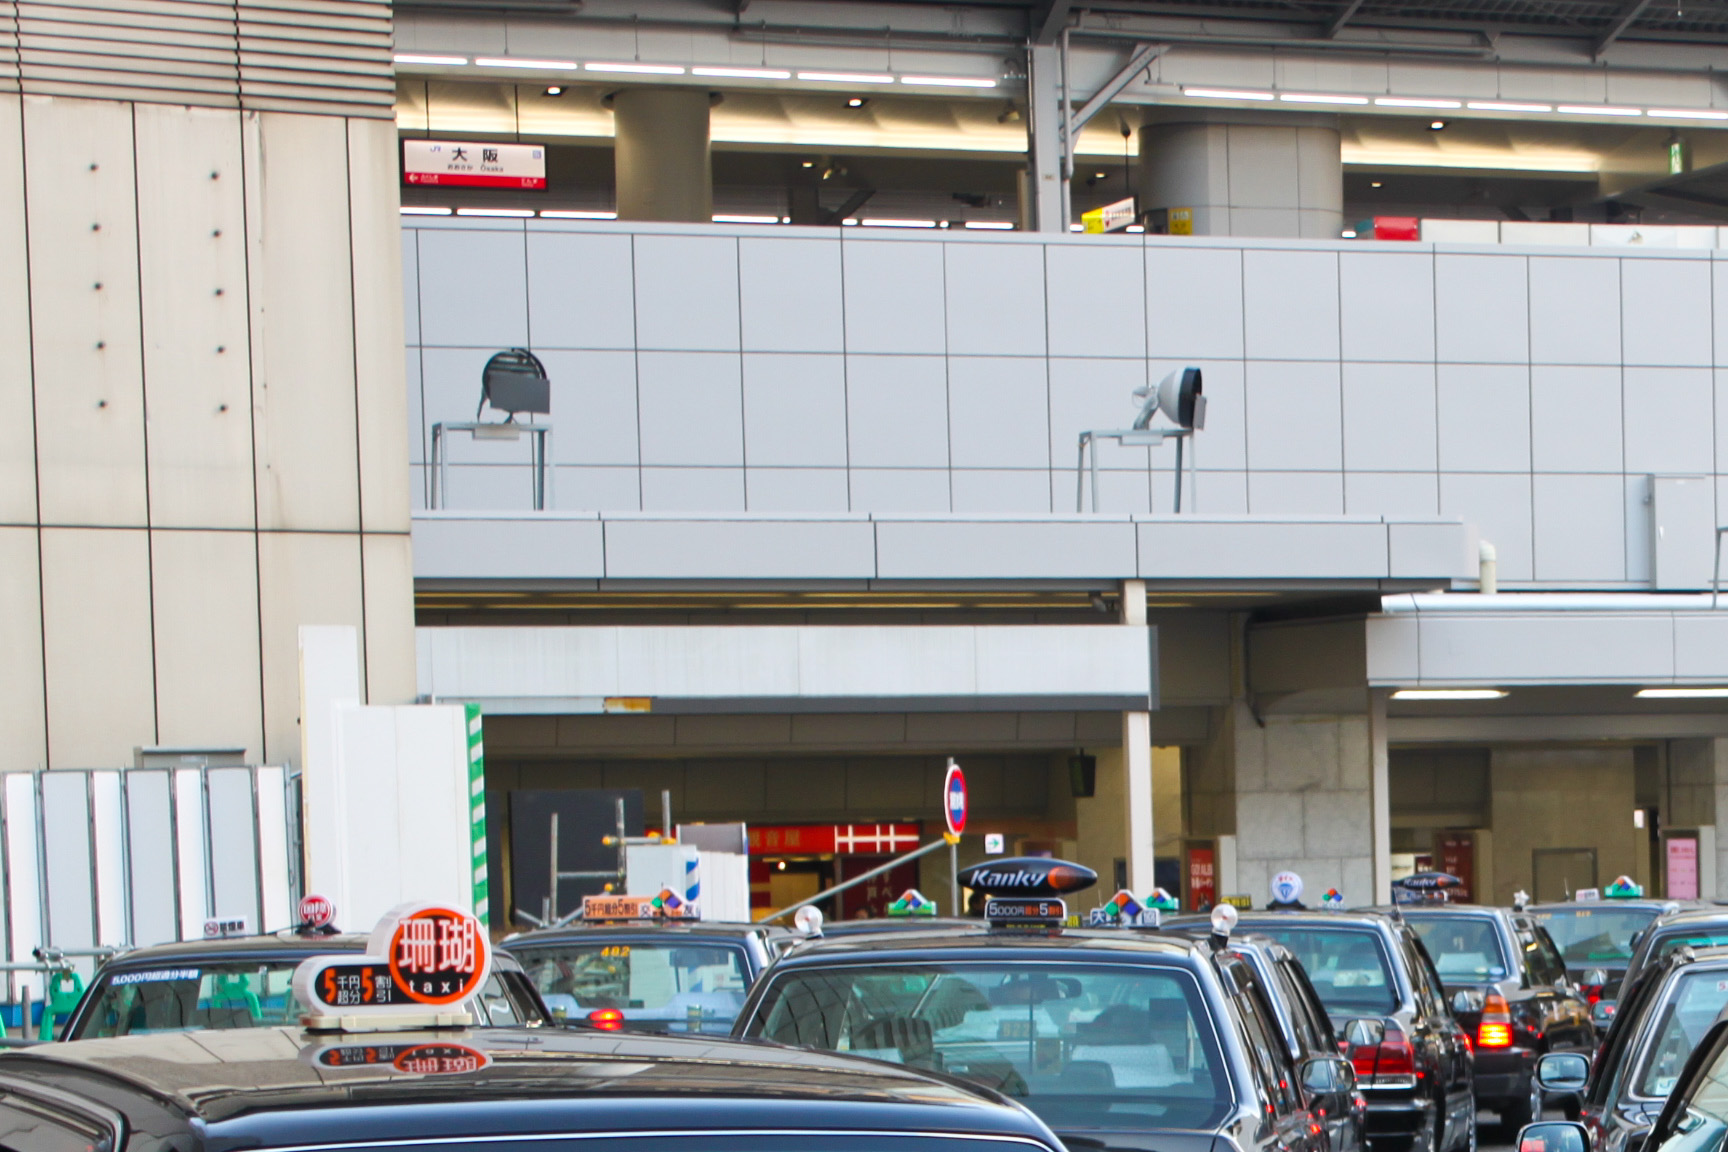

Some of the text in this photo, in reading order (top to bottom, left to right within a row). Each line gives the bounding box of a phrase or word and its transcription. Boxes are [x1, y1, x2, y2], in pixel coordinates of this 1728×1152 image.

[452, 147, 498, 163] 大阪
[970, 870, 1046, 886] Kanky
[398, 918, 476, 973] 珊瑚
